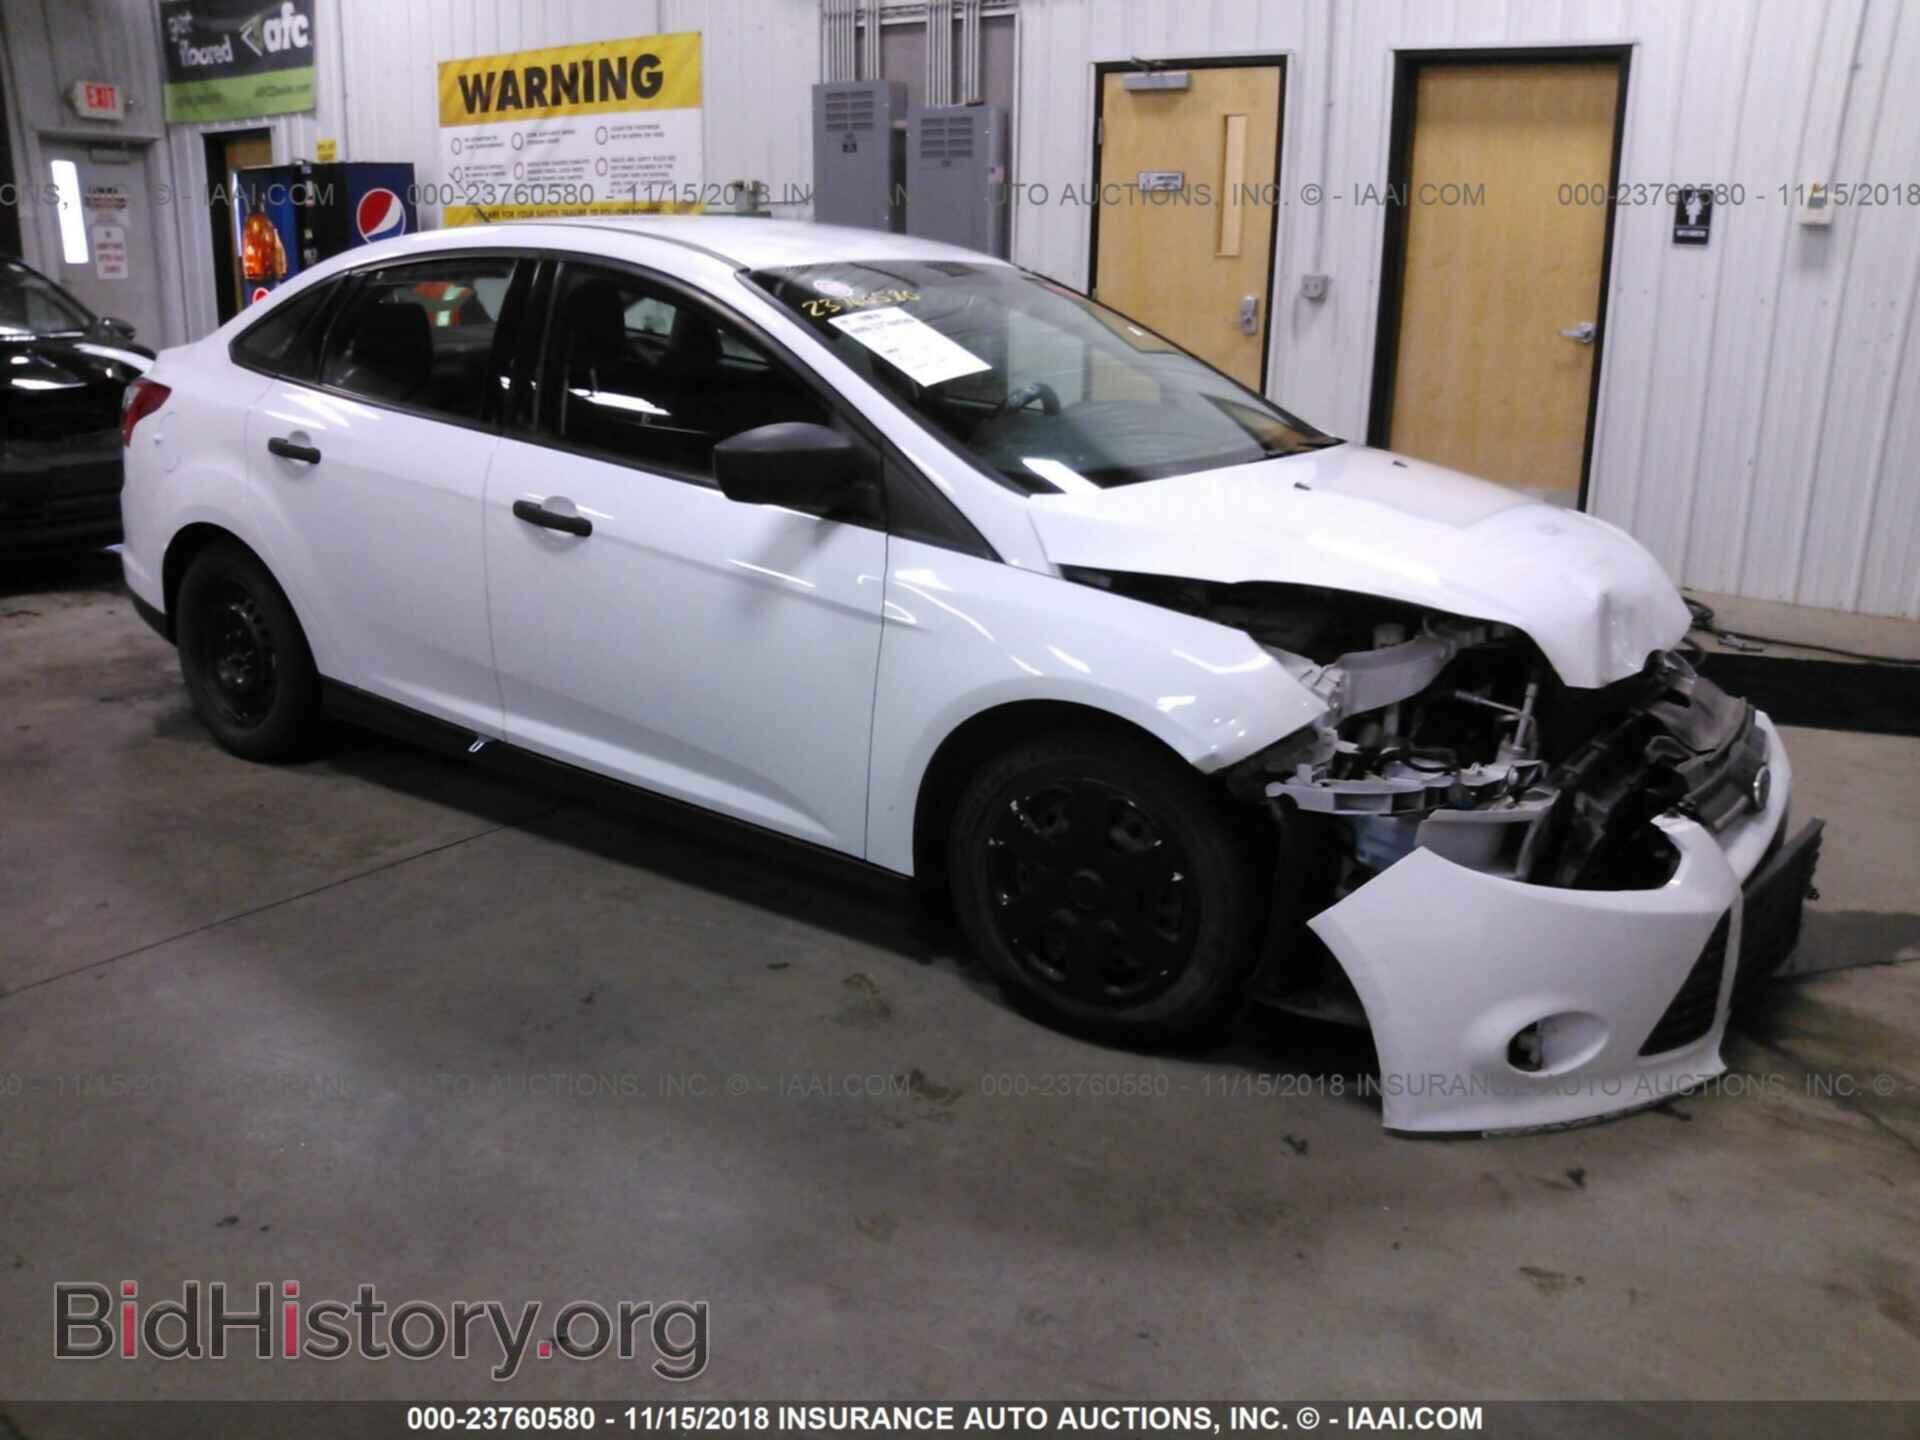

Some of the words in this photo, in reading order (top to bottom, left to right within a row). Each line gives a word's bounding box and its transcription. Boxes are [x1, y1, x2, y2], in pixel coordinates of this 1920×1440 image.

[263, 1, 309, 53] afc
[85, 84, 117, 112] EXIT
[458, 53, 664, 115] WARNING
